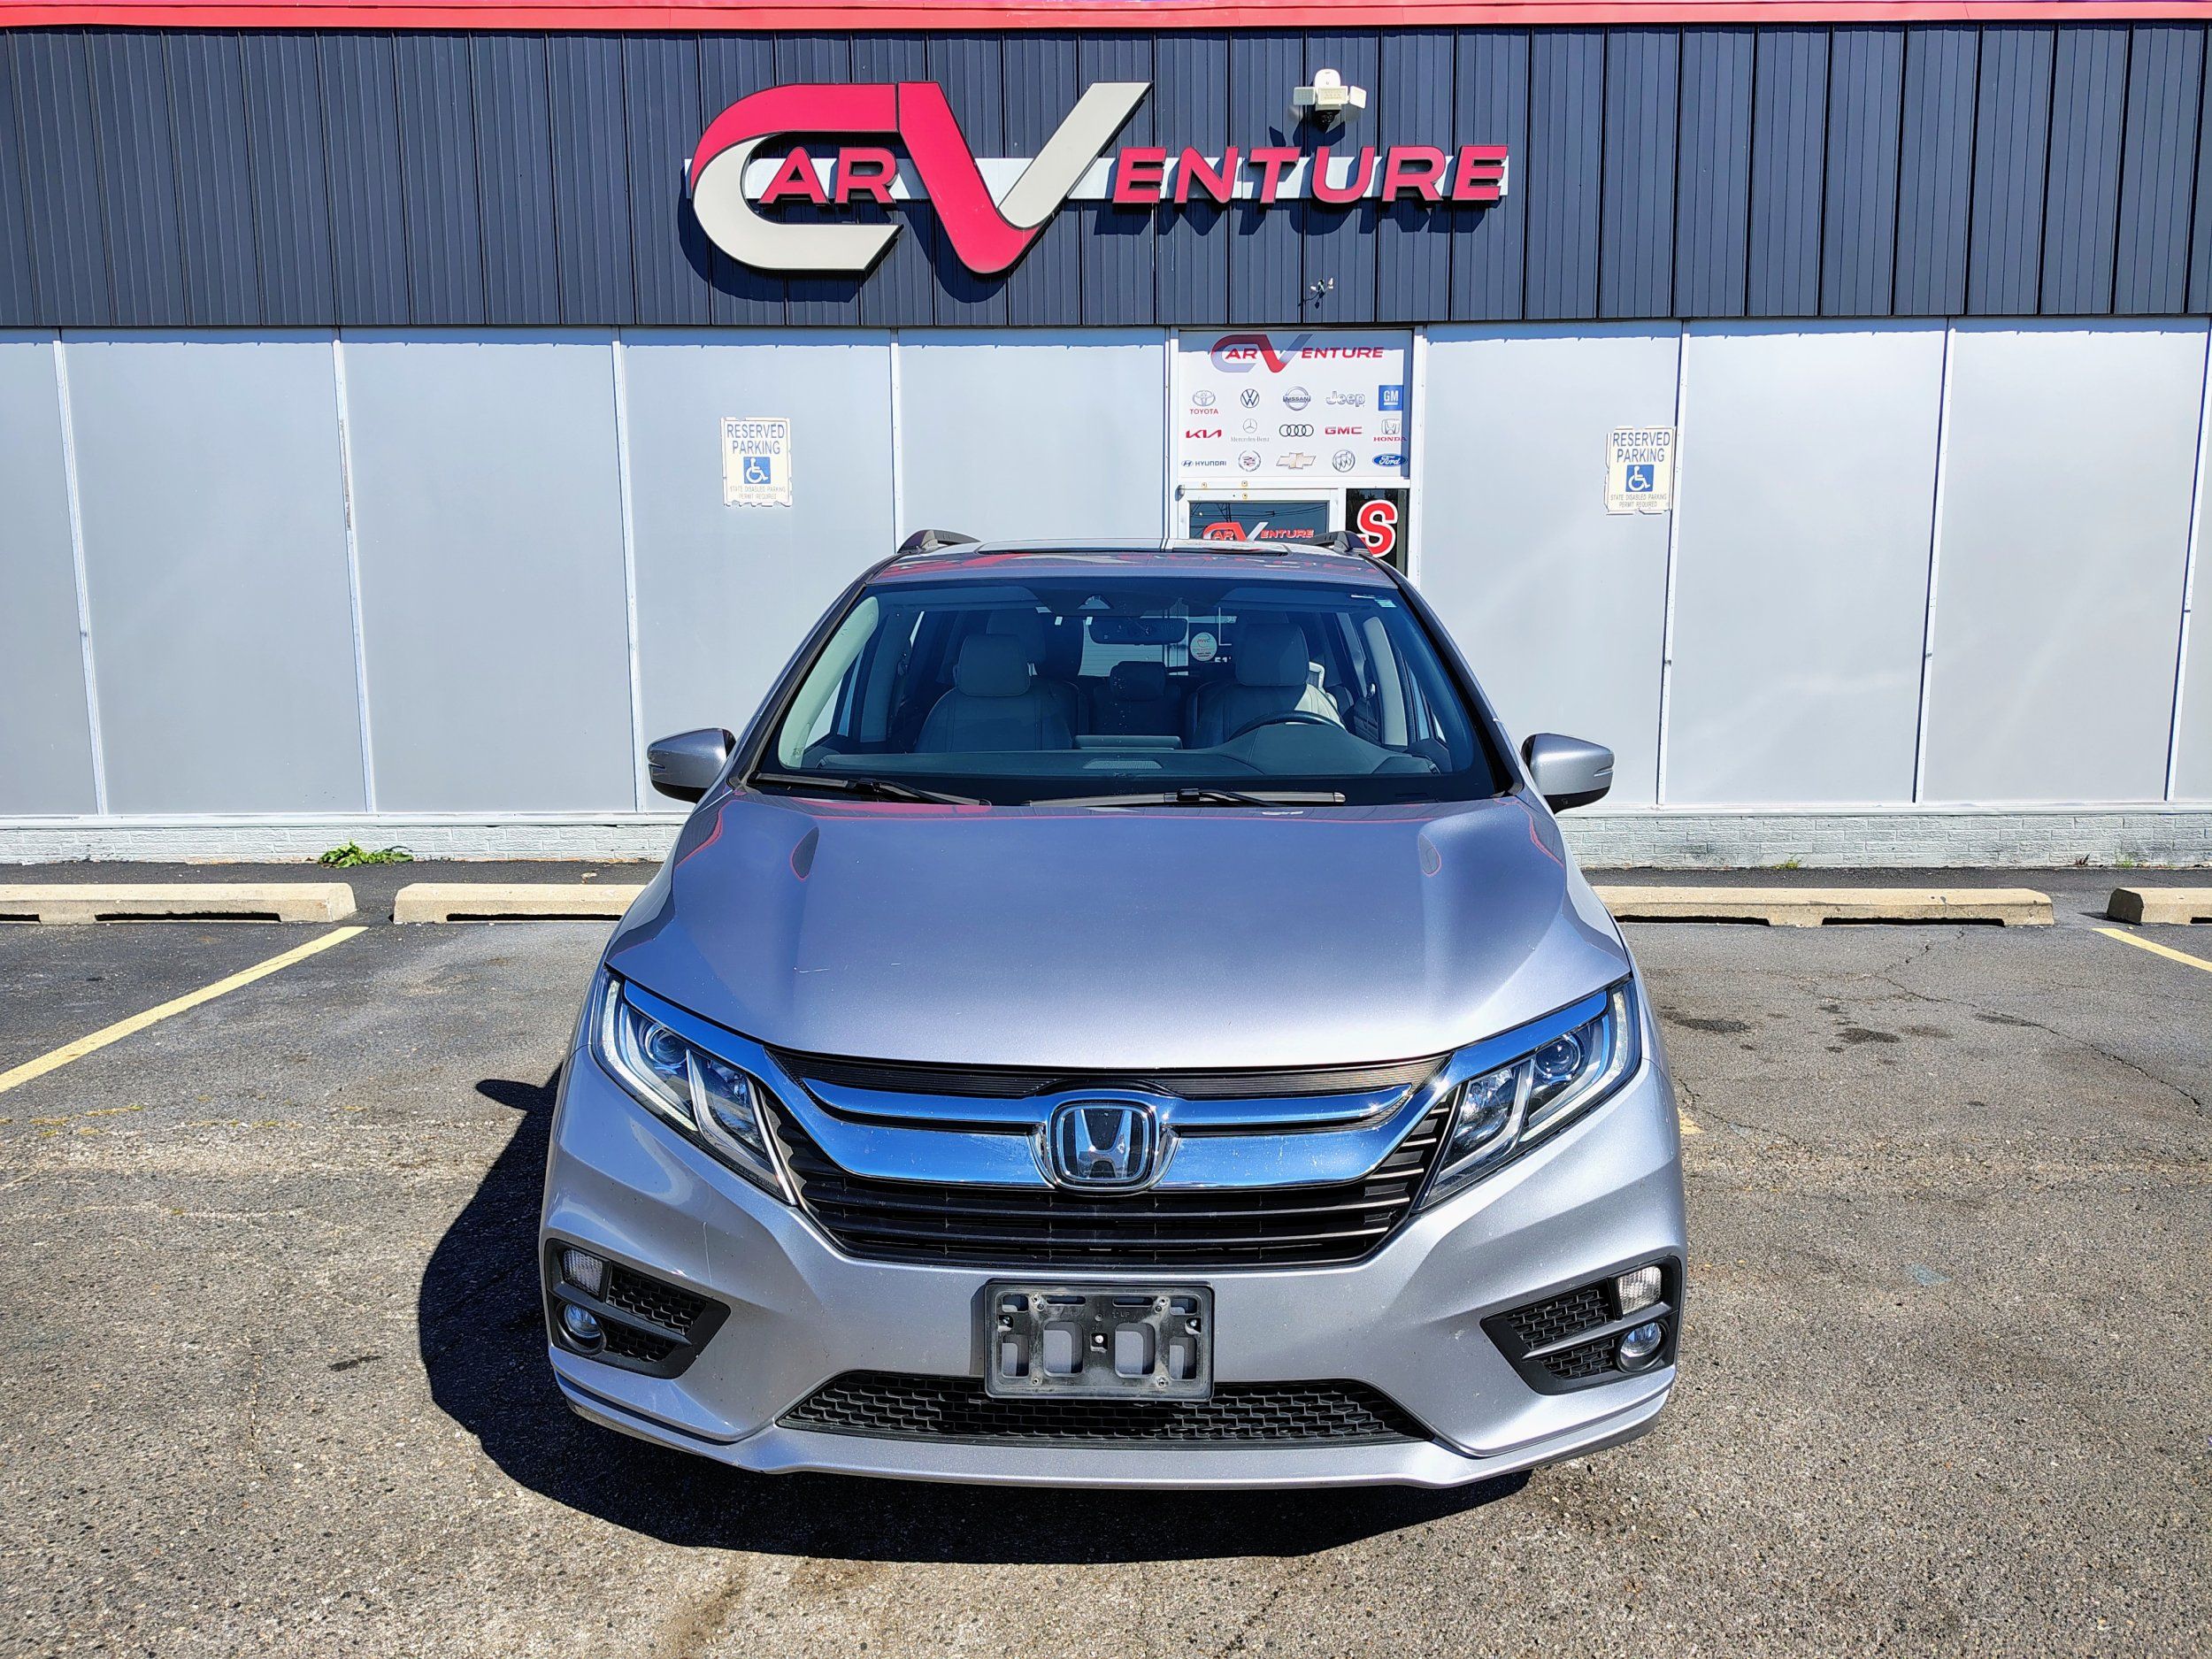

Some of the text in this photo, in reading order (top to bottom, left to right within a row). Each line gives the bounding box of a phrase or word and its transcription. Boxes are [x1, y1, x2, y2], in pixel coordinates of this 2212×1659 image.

[1325, 390, 1366, 407] Jeep
[1384, 390, 1399, 402] GM
[726, 423, 785, 439] RESERVED
[1186, 429, 1222, 439] KIA
[1325, 426, 1363, 434] GMC
[1612, 432, 1671, 447] RESERVED
[732, 440, 780, 455] PARKING
[1379, 455, 1401, 466] Ford
[1617, 448, 1665, 463] PARKING
